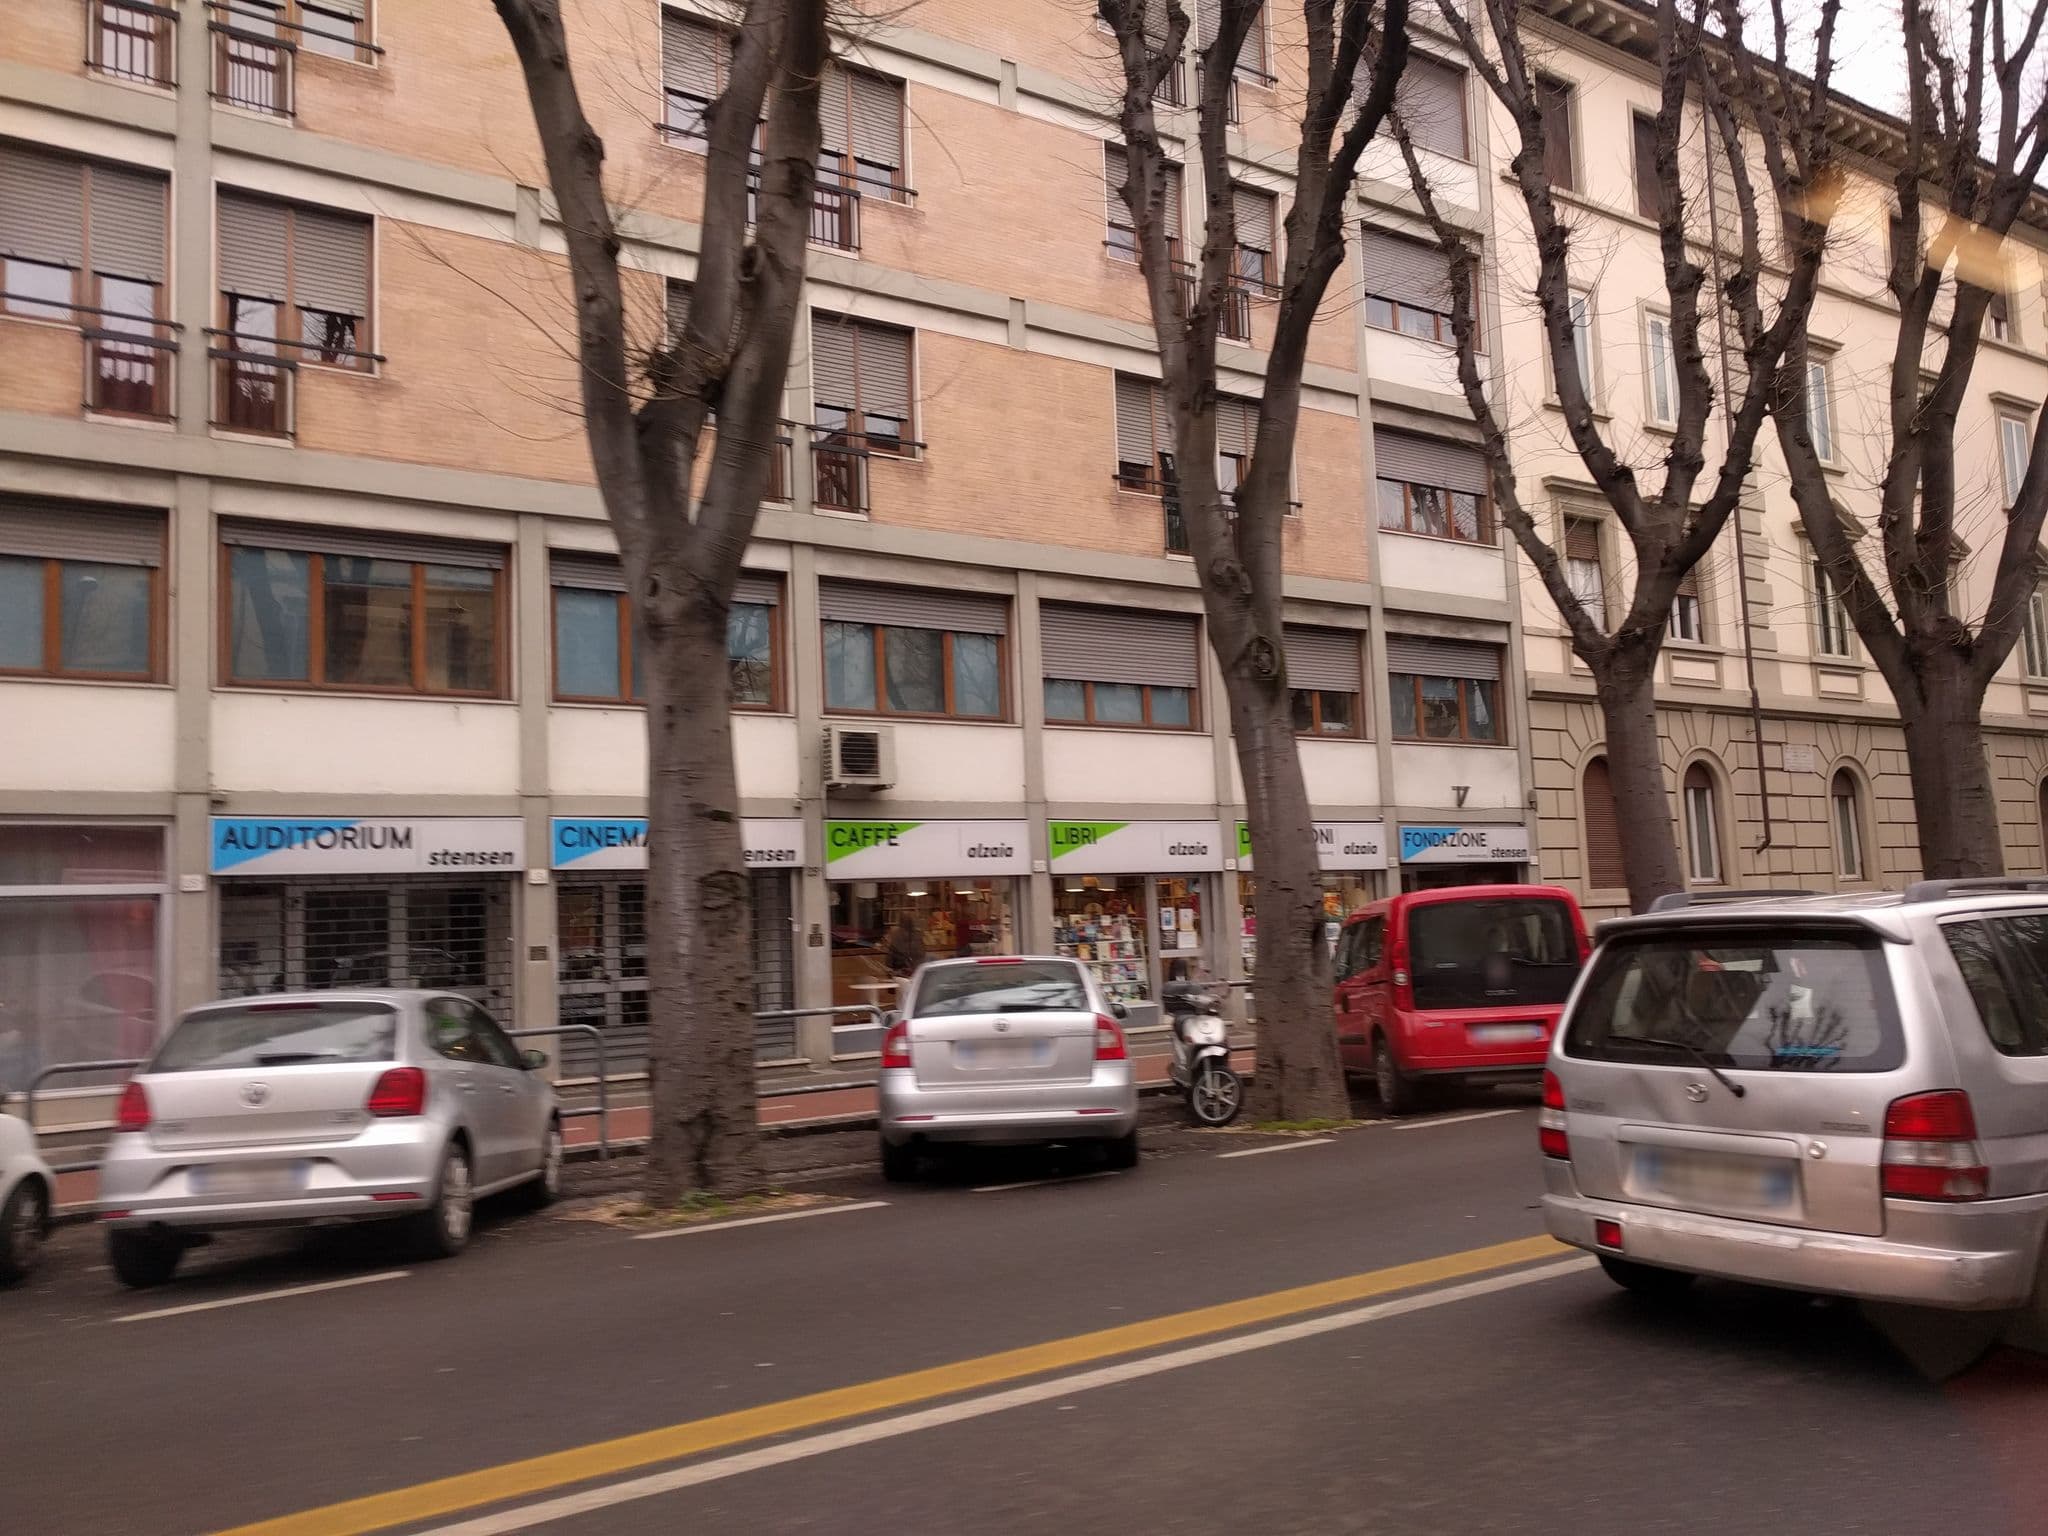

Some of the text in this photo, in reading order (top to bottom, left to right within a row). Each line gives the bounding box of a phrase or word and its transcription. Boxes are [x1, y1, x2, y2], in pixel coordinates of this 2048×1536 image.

[221, 826, 412, 850] AUDITORIUM
[559, 826, 649, 848] CINEM
[831, 824, 899, 847] CAFFÈ
[1053, 827, 1097, 845] LIBRI
[1404, 832, 1487, 848] FONDAZIONE
[743, 850, 796, 862] ensen
[967, 843, 1014, 858] alzaia
[1168, 842, 1209, 856] alzaia
[1343, 842, 1379, 855] alzaia
[1491, 848, 1528, 858] stensen
[429, 850, 514, 866] stensen
